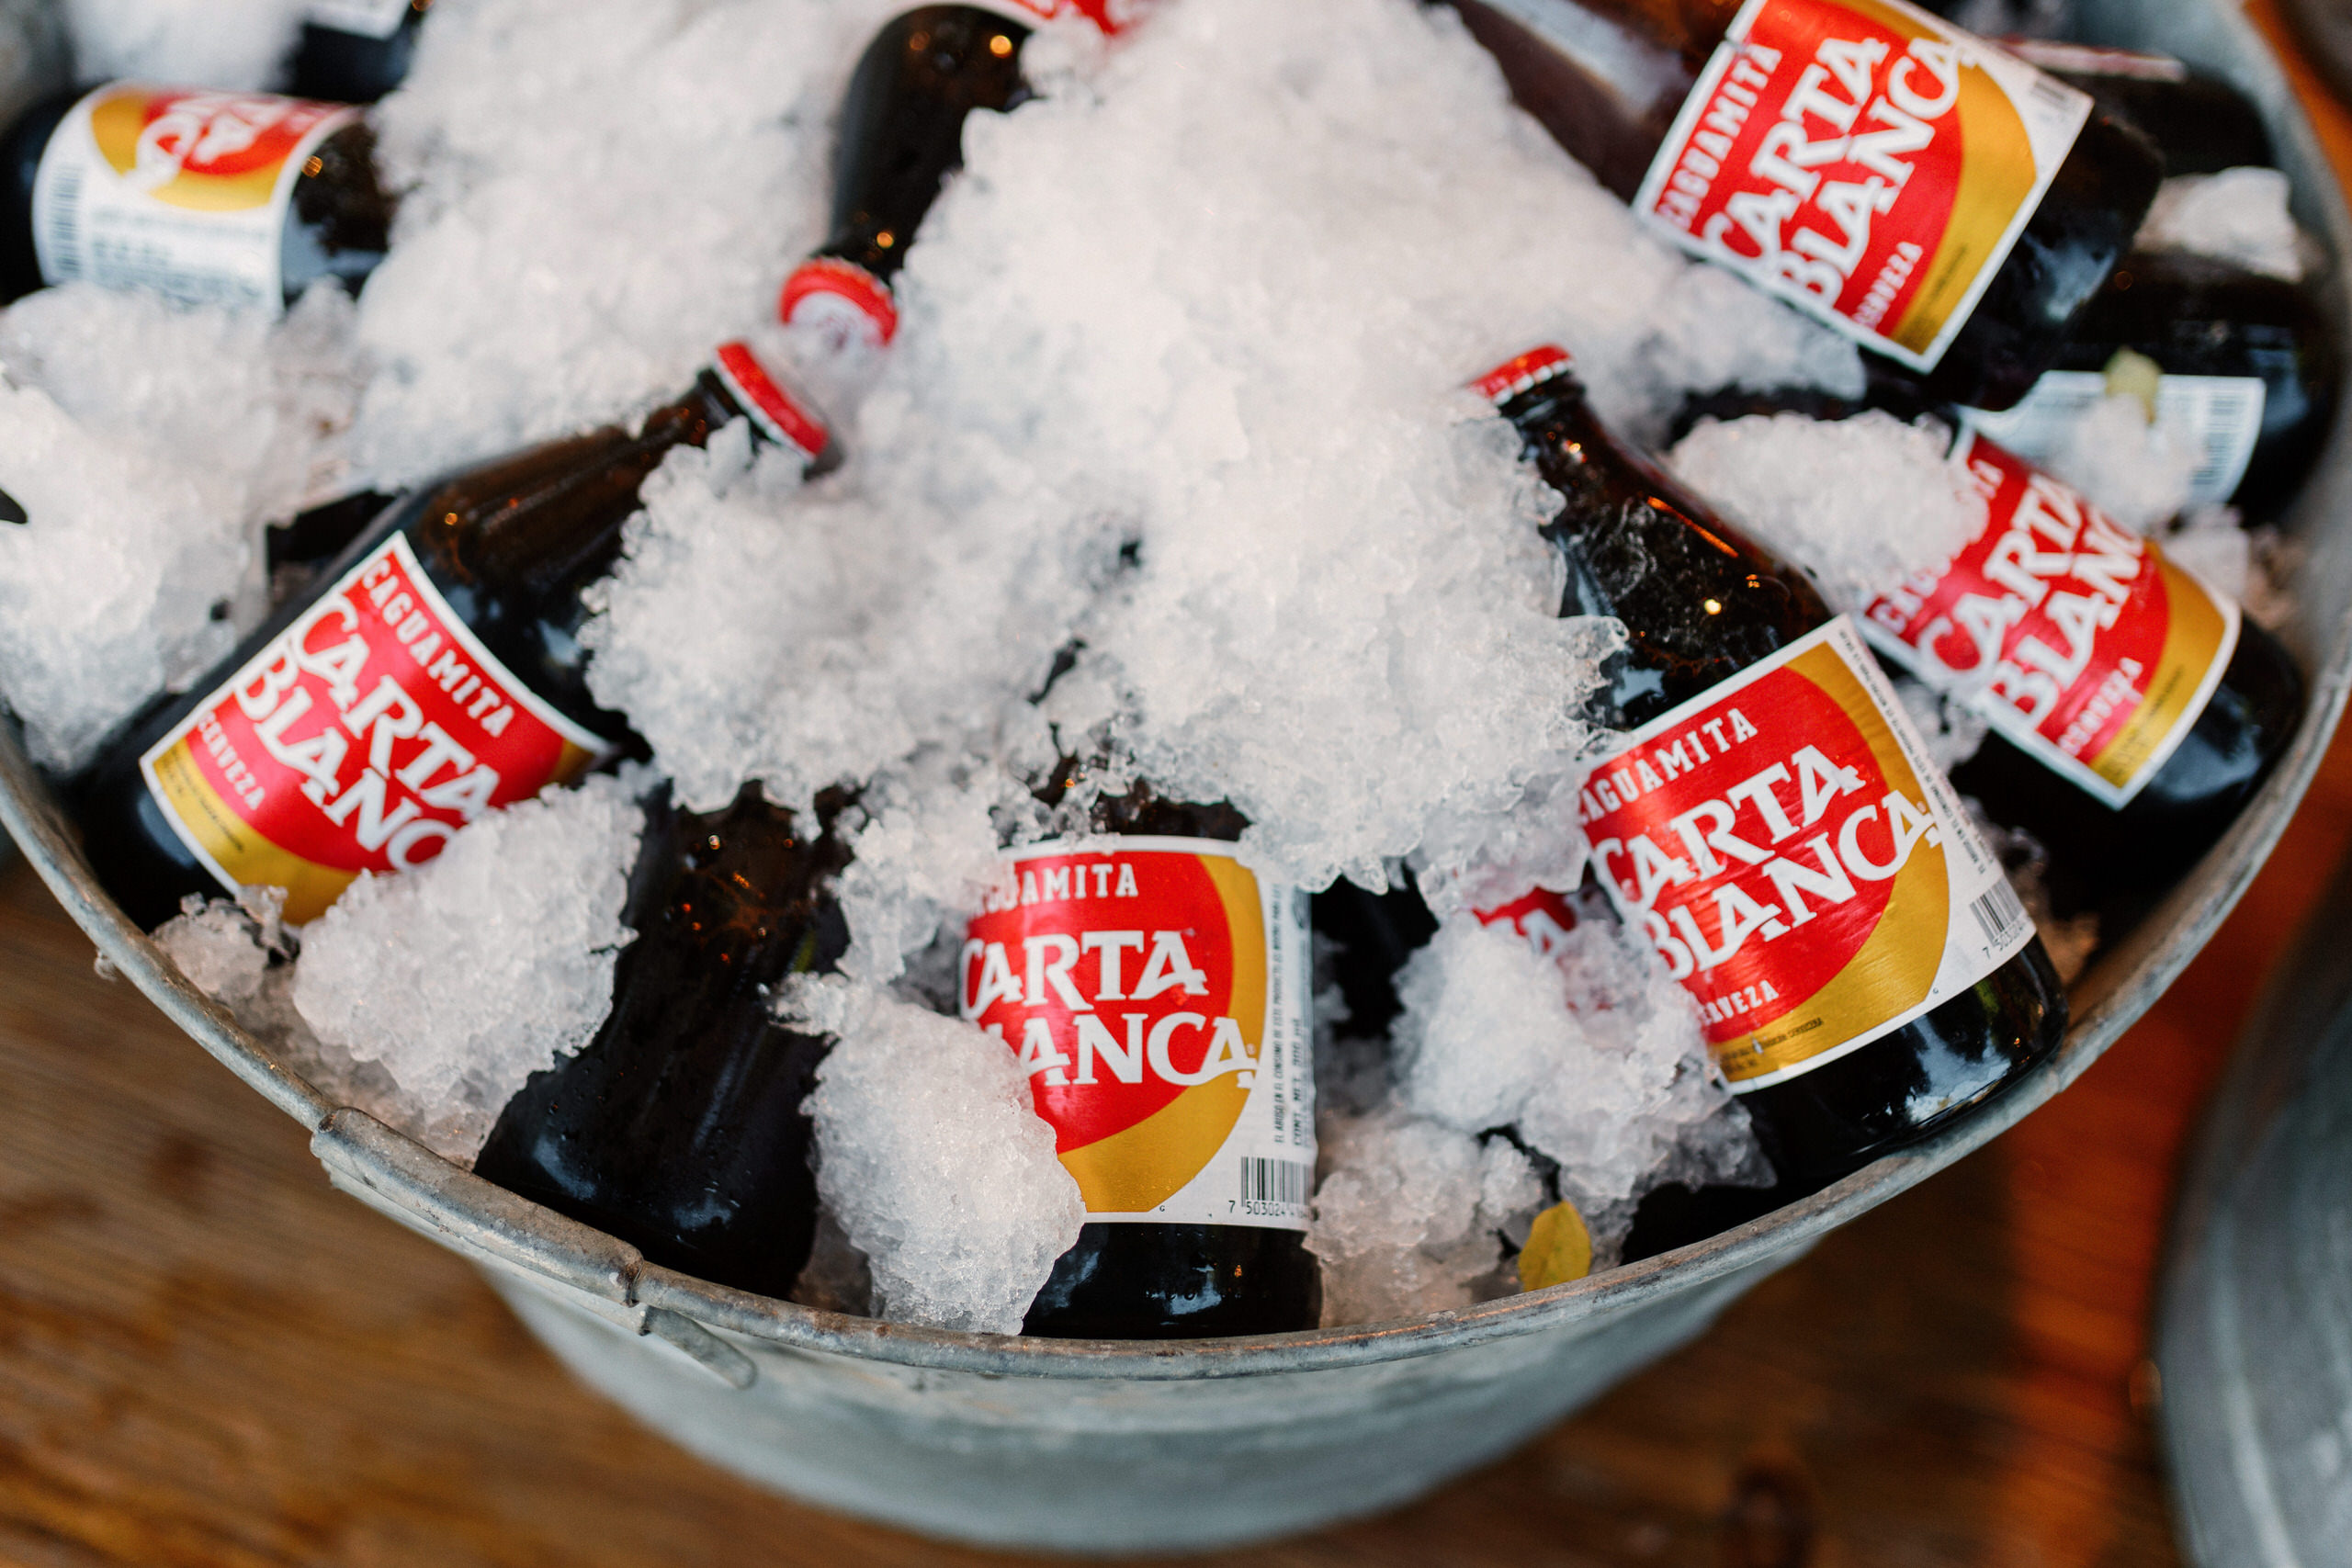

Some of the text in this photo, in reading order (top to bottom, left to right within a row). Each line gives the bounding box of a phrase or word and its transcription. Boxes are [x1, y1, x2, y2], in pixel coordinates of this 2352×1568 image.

[1702, 37, 1889, 270] CARTA
[1777, 37, 1979, 310] BLANCA
[362, 557, 516, 737] CAGUAMITA
[1983, 508, 2144, 733] BLAN
[198, 711, 266, 812] CERVEZA
[232, 645, 459, 873] BLANC
[295, 595, 500, 827] CARTA
[1579, 707, 1758, 825] AGUAMITA
[1591, 744, 1866, 915] CARTA
[1644, 789, 1943, 981] BLANCA
[959, 930, 1209, 1021] CARTA
[985, 1012, 1259, 1089] ANCA
[1698, 979, 1780, 1027] RVEZA
[1227, 1200, 1236, 1213] 7
